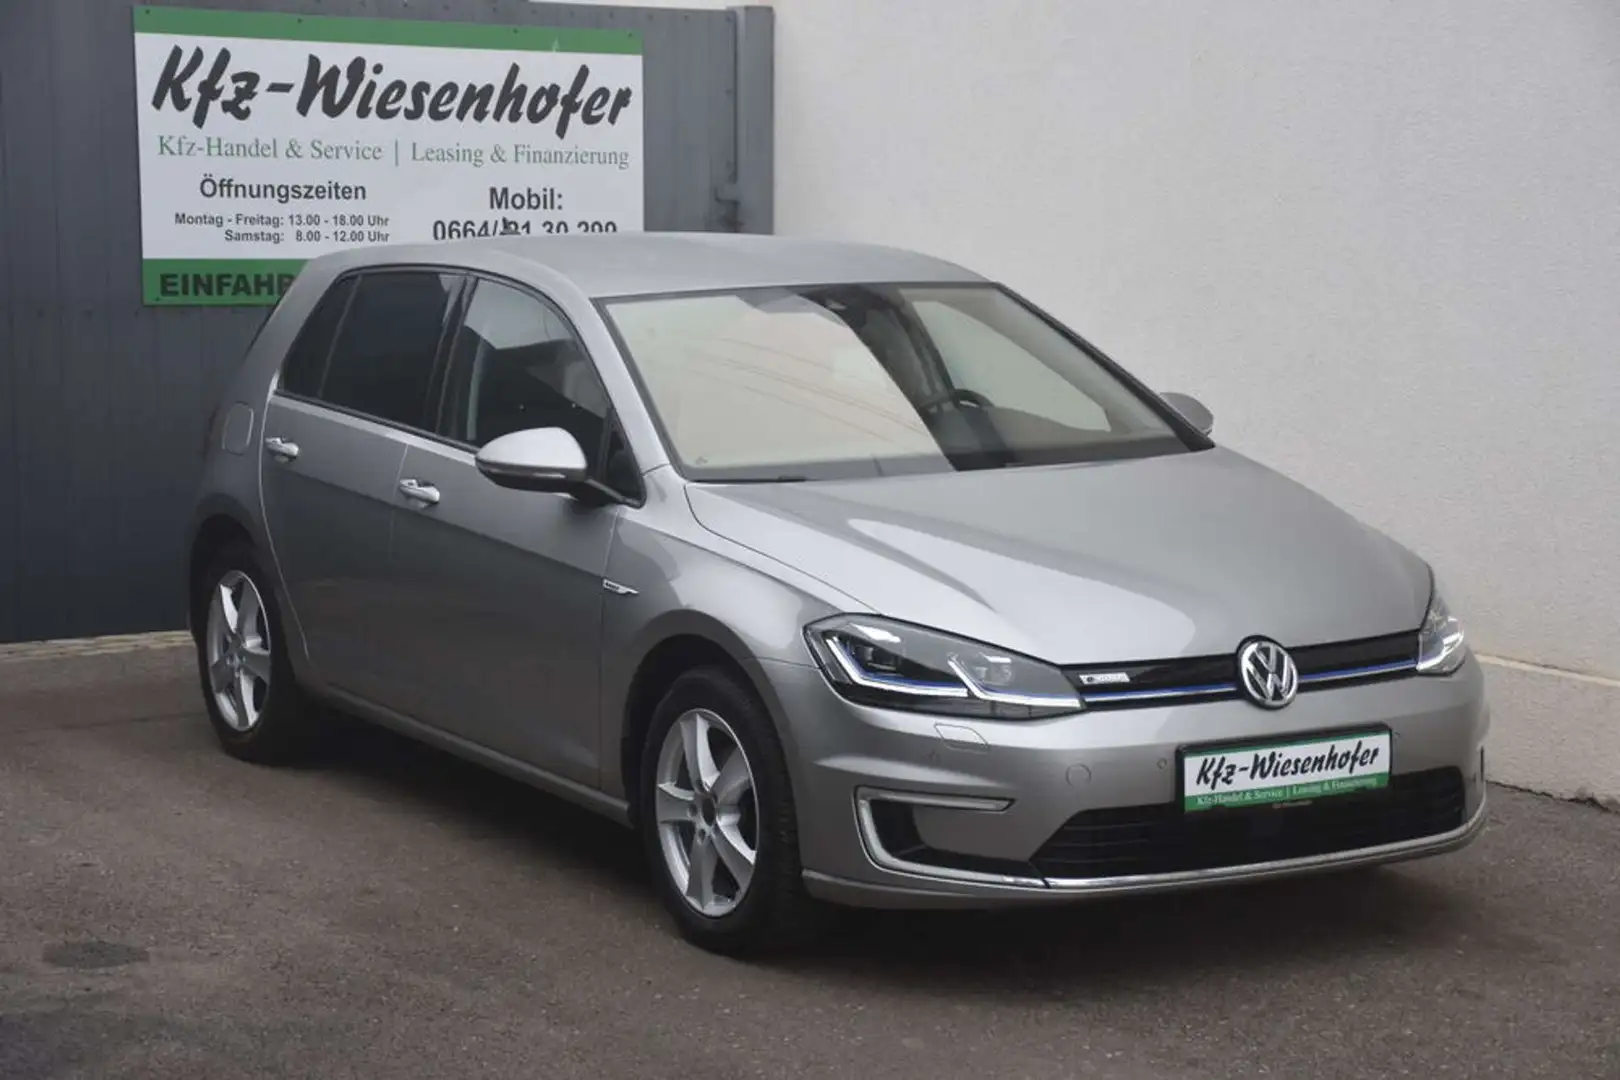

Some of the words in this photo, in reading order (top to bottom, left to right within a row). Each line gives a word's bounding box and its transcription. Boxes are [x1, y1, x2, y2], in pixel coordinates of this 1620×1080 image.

[151, 44, 633, 140] Kfz-Wiesenhofer
[157, 134, 279, 159] Kfz-Handel
[285, 139, 303, 159] &
[310, 140, 383, 161] Service
[411, 142, 484, 168] Leasing
[490, 145, 507, 163] &
[513, 144, 630, 170] Finanzierung
[199, 173, 367, 204] Öffnungszeiten
[489, 186, 563, 211] Mobil:
[174, 212, 224, 227] Montag
[235, 213, 285, 228] Freitag:
[287, 214, 321, 227] 13.00
[332, 215, 364, 227] 18.00
[367, 215, 390, 227] Uhr
[224, 229, 285, 244] Samstag:
[295, 230, 322, 243] 8.00
[333, 231, 365, 243] 12.00
[367, 231, 390, 243] Uhr
[1196, 740, 1380, 791] Kfz-Wiesenhofer
